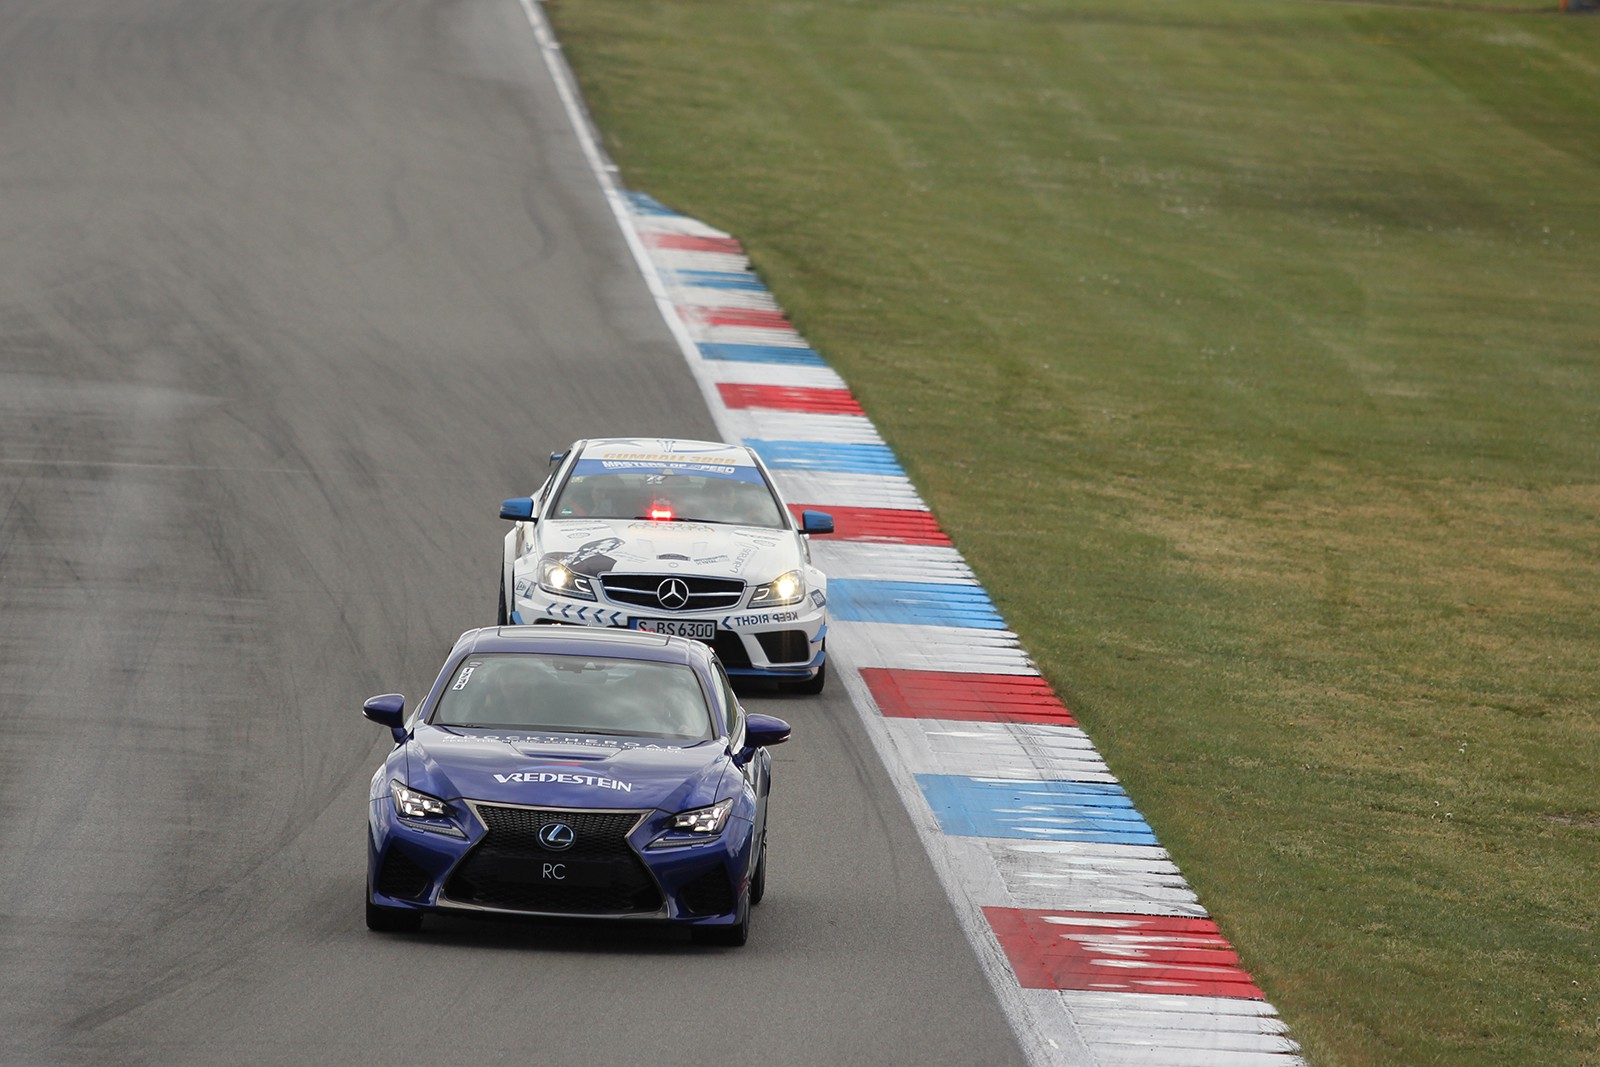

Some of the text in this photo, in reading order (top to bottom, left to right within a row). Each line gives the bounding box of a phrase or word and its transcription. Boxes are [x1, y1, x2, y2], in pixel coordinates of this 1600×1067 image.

[602, 460, 736, 475] MASTERS OF SPEED
[493, 773, 632, 793] VREDESTEIN
[542, 863, 566, 880] RC
